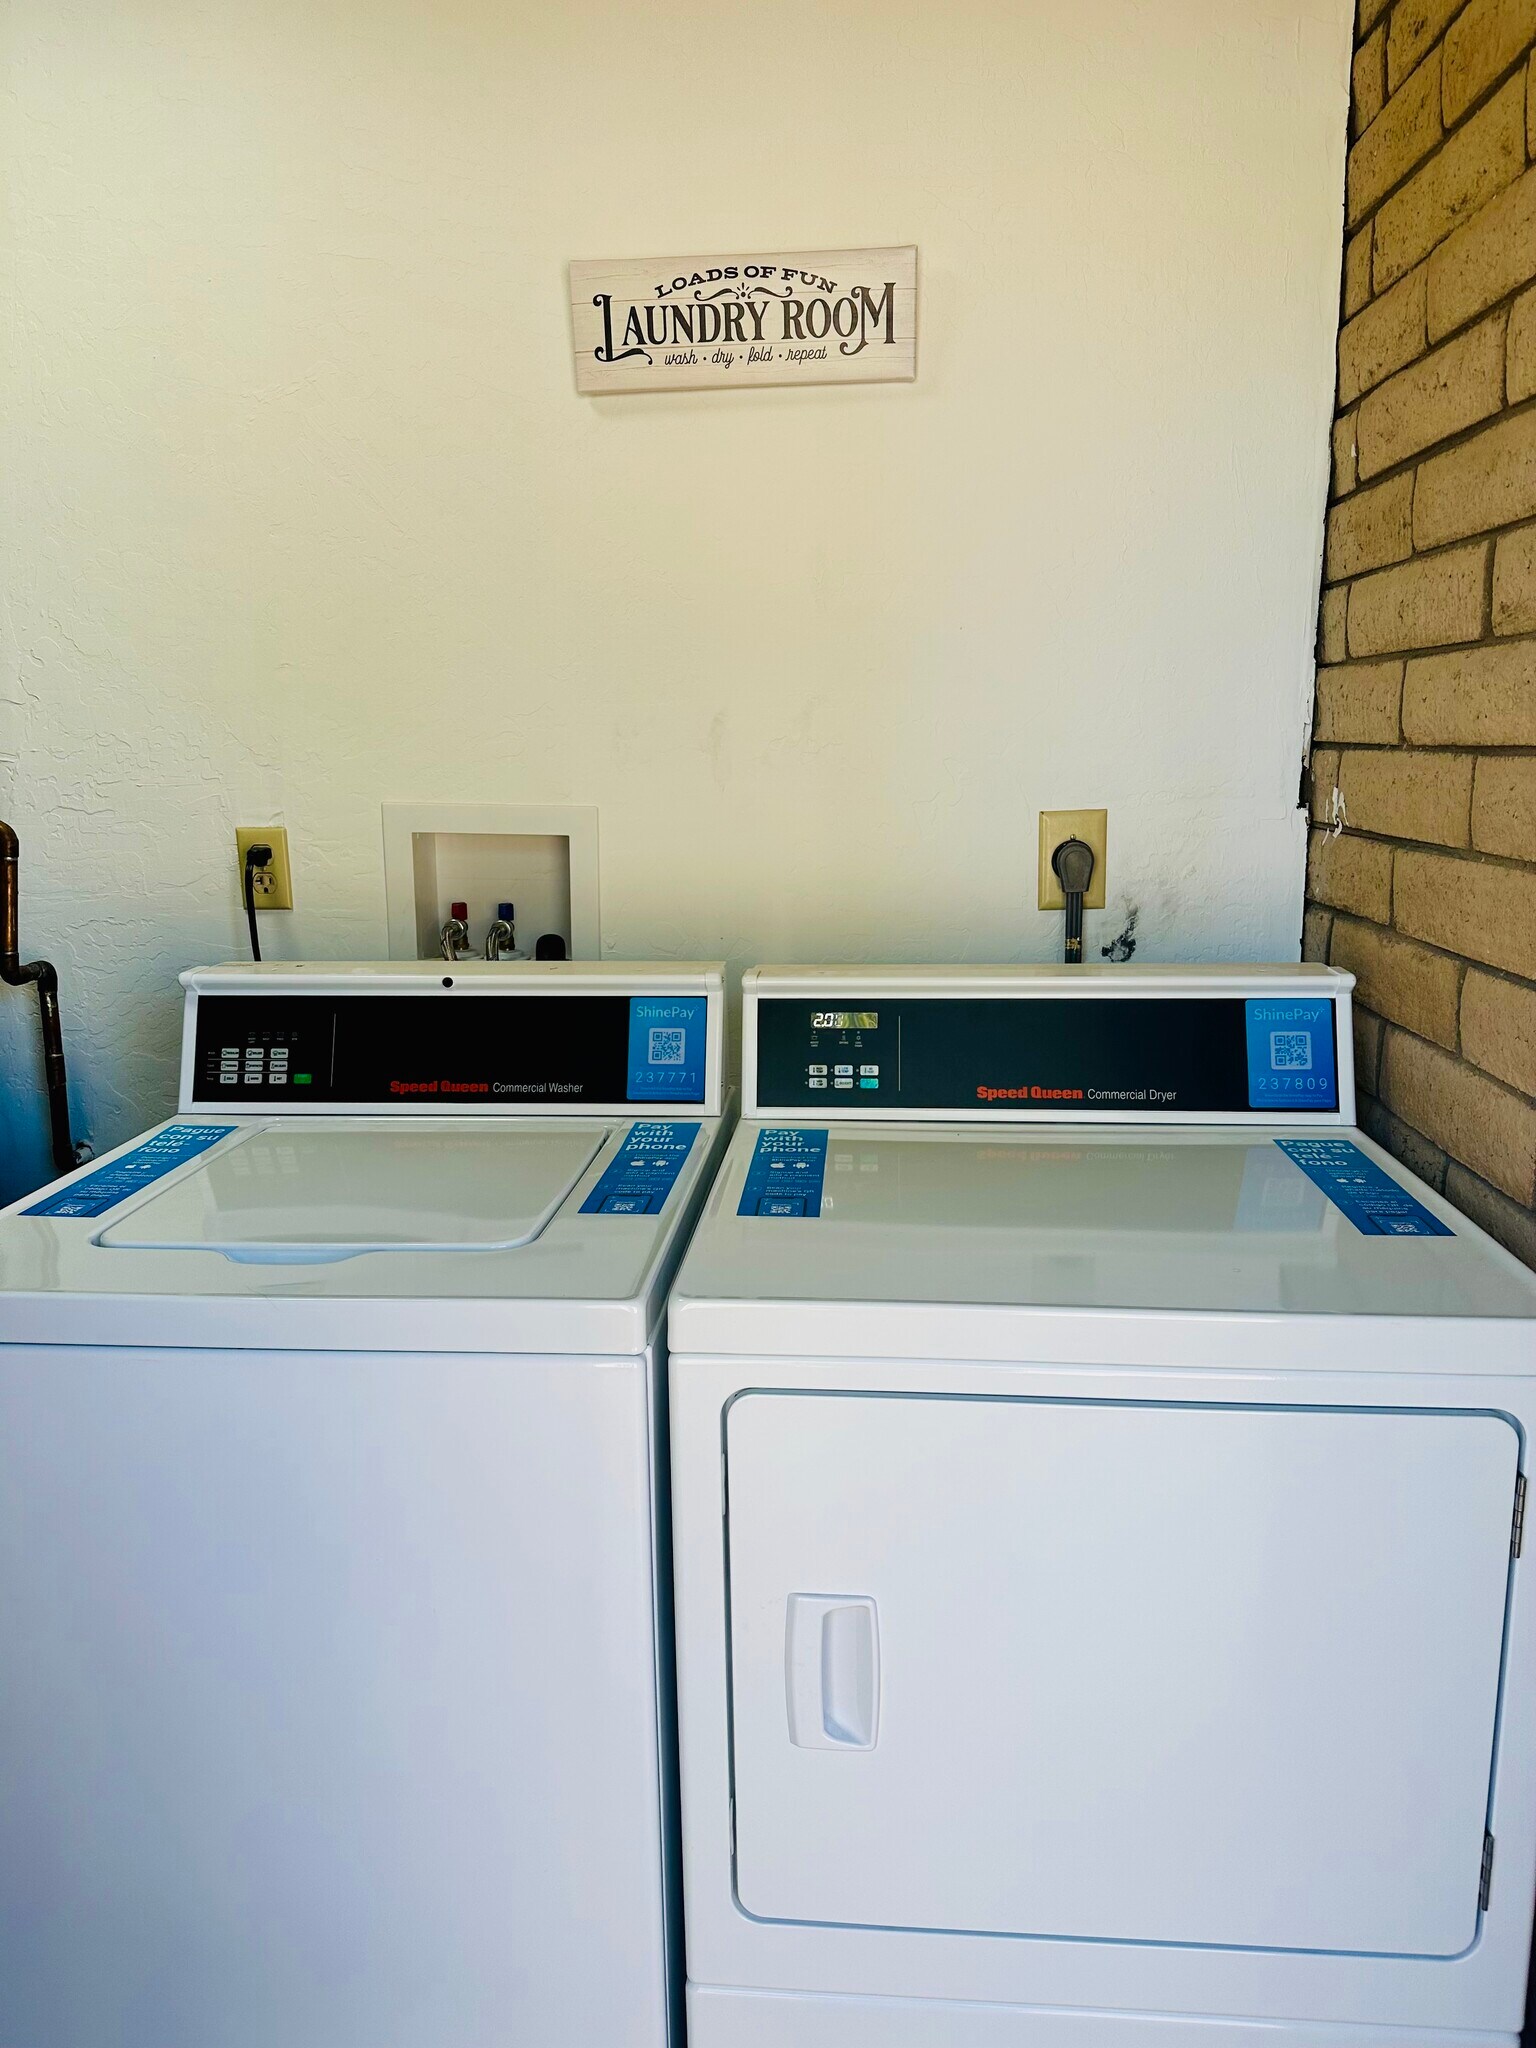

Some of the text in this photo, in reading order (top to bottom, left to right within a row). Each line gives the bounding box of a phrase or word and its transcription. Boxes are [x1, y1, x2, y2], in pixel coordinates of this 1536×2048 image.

[654, 265, 838, 298] LOADS OF FUN
[593, 282, 896, 365] LAUNDRY ROOM
[665, 346, 827, 369] wash dry fold repeat
[636, 1006, 695, 1020] ShinePay
[1254, 1007, 1320, 1022] ShinePay
[635, 1072, 696, 1084] 237771
[1258, 1077, 1328, 1090] 237809
[390, 1080, 583, 1095] Speed Queen Commercial Washer
[977, 1086, 1177, 1103] Speed Queen Commercial Dryer
[169, 1126, 226, 1135] Pague
[149, 1139, 190, 1147] telé-
[1280, 1140, 1346, 1148] Pague
